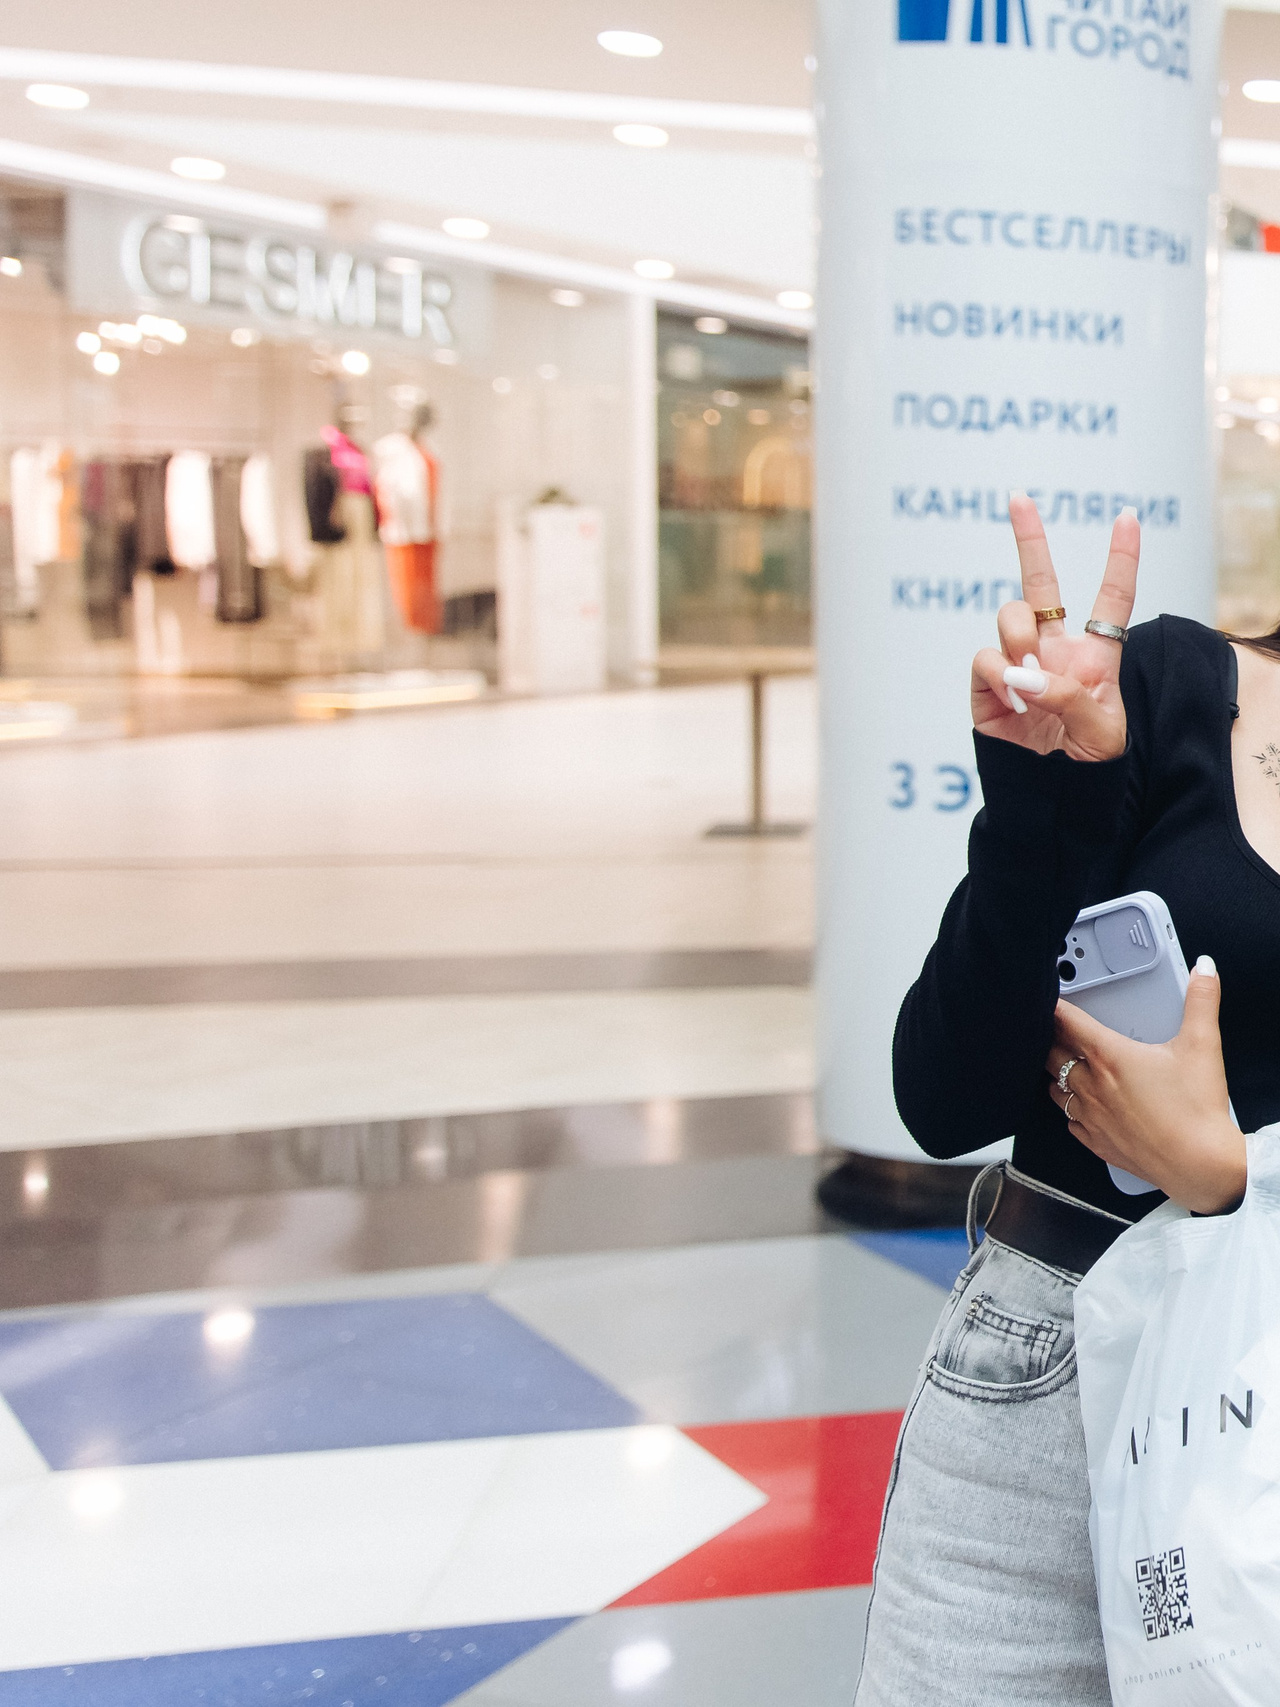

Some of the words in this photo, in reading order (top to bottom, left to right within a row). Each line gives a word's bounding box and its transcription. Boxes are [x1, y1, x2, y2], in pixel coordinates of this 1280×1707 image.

[1047, 14, 1191, 80] ГОРОД
[895, 206, 1191, 266] БЕСТСЕЛЛЕРЫ
[894, 301, 1124, 346] НОВИНКИ
[894, 393, 1118, 435] ПОДАРКИ
[889, 761, 915, 809] 3
[935, 764, 972, 811] Э
[1124, 1674, 1144, 1686] shop
[1148, 1665, 1182, 1681] online
